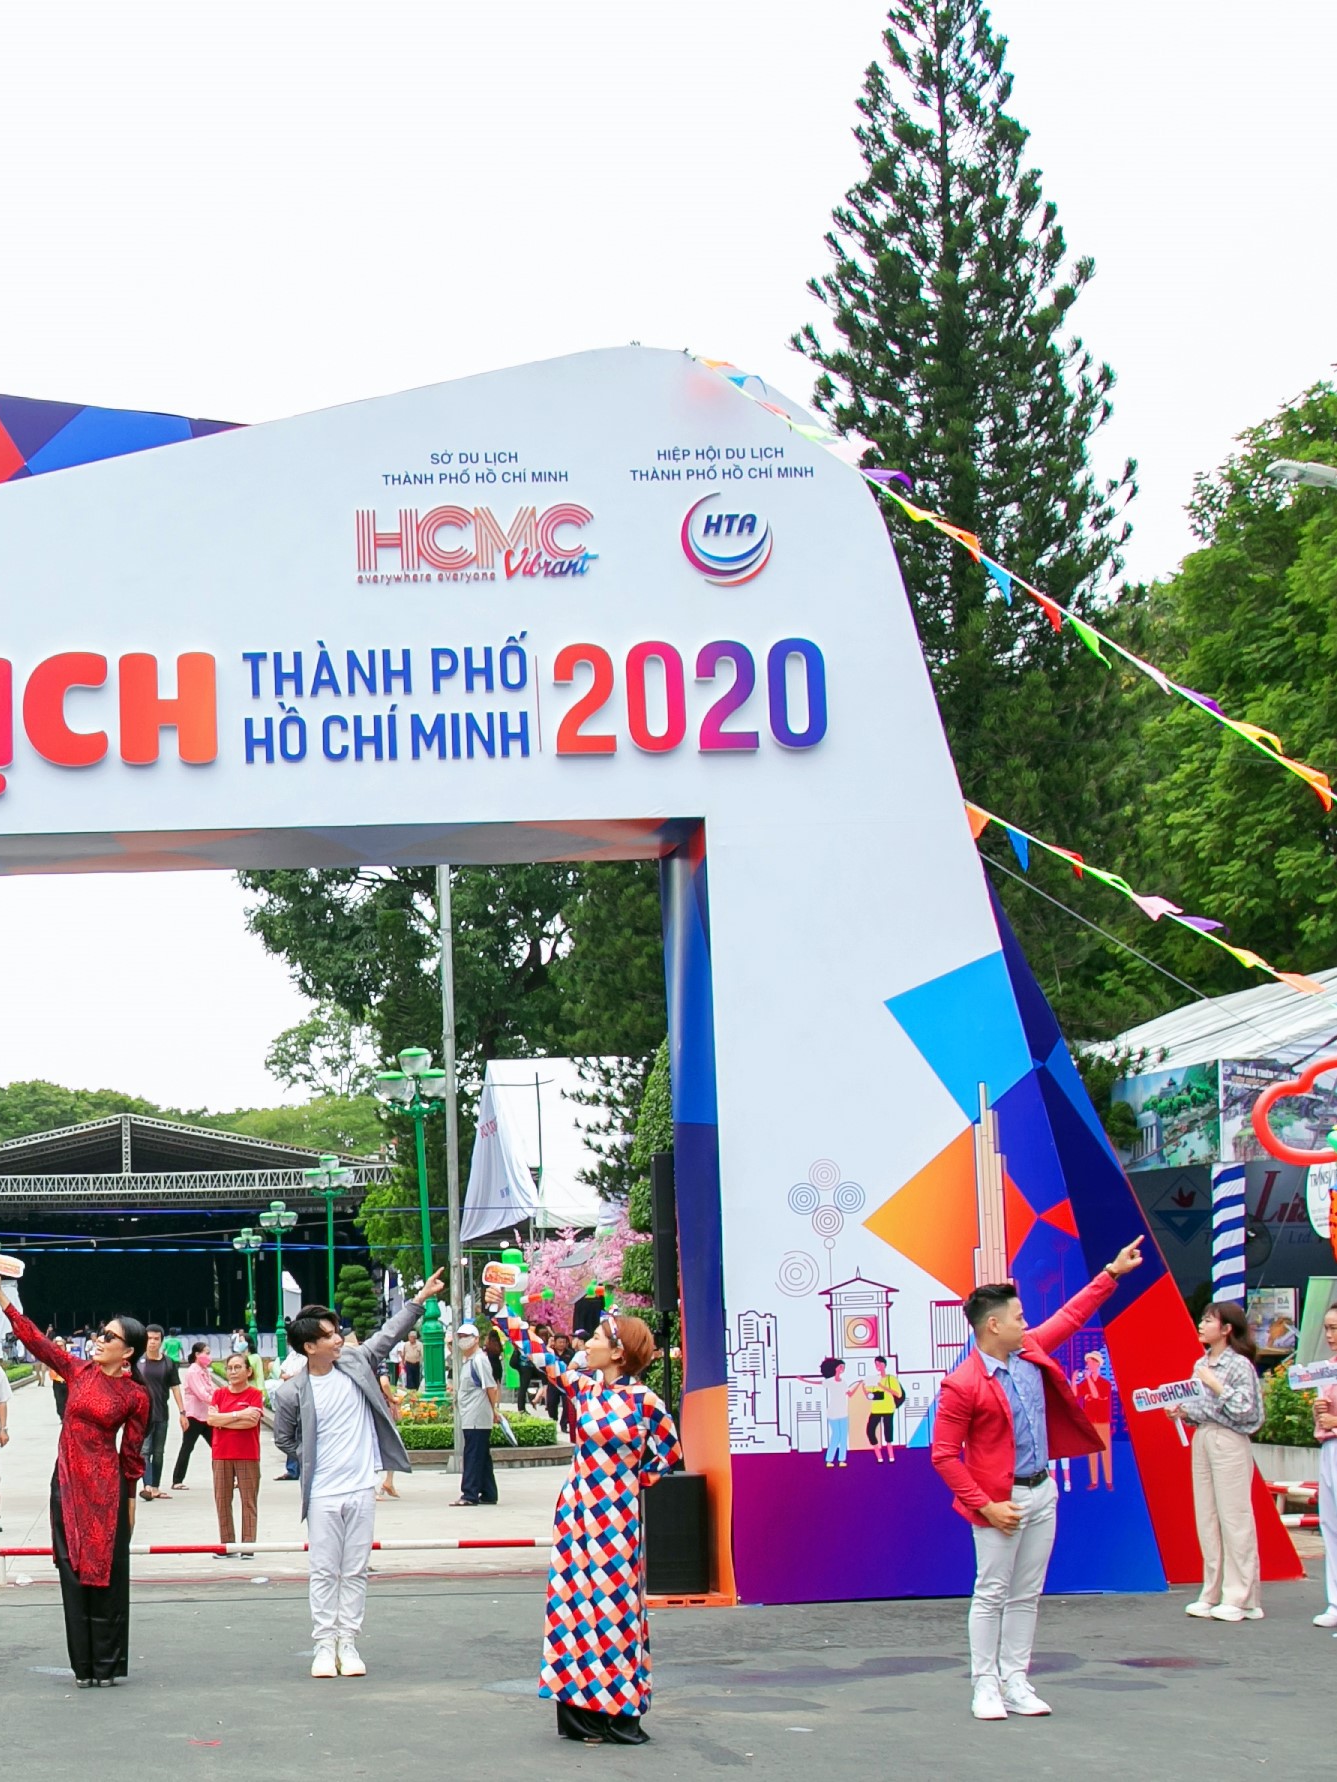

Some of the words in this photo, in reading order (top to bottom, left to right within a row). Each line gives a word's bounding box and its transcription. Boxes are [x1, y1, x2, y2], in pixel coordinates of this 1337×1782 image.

[430, 450, 453, 465] SỞ
[459, 452, 479, 464] DU
[484, 451, 519, 466] LỊCH
[657, 446, 691, 463] HIỆP
[695, 445, 721, 463] HỘI
[725, 448, 746, 460] DU
[751, 446, 785, 462] LỊCH
[381, 470, 434, 486] THÀNH
[439, 467, 471, 484] PHỐ
[475, 467, 497, 483] HỒ
[502, 470, 527, 483] CHÍ
[531, 471, 569, 483] MINH
[630, 466, 681, 482] THÀNH
[686, 464, 718, 481] PHỐ
[722, 463, 744, 480] HỒ
[748, 464, 773, 479] CHÍ
[777, 466, 814, 478] MINH
[356, 502, 594, 572] HCMC
[703, 513, 758, 536] HTA
[504, 546, 600, 580] Vibrant
[357, 572, 432, 586] everywhere
[437, 571, 496, 584] everyone
[242, 640, 413, 699] THÀNH
[430, 630, 528, 694] PHỐ
[552, 636, 828, 757] 2020
[244, 701, 308, 765] HỒ
[322, 703, 398, 762] CHÍ
[410, 710, 531, 761] MINH
[1135, 1380, 1200, 1407] #iloveHCMC
